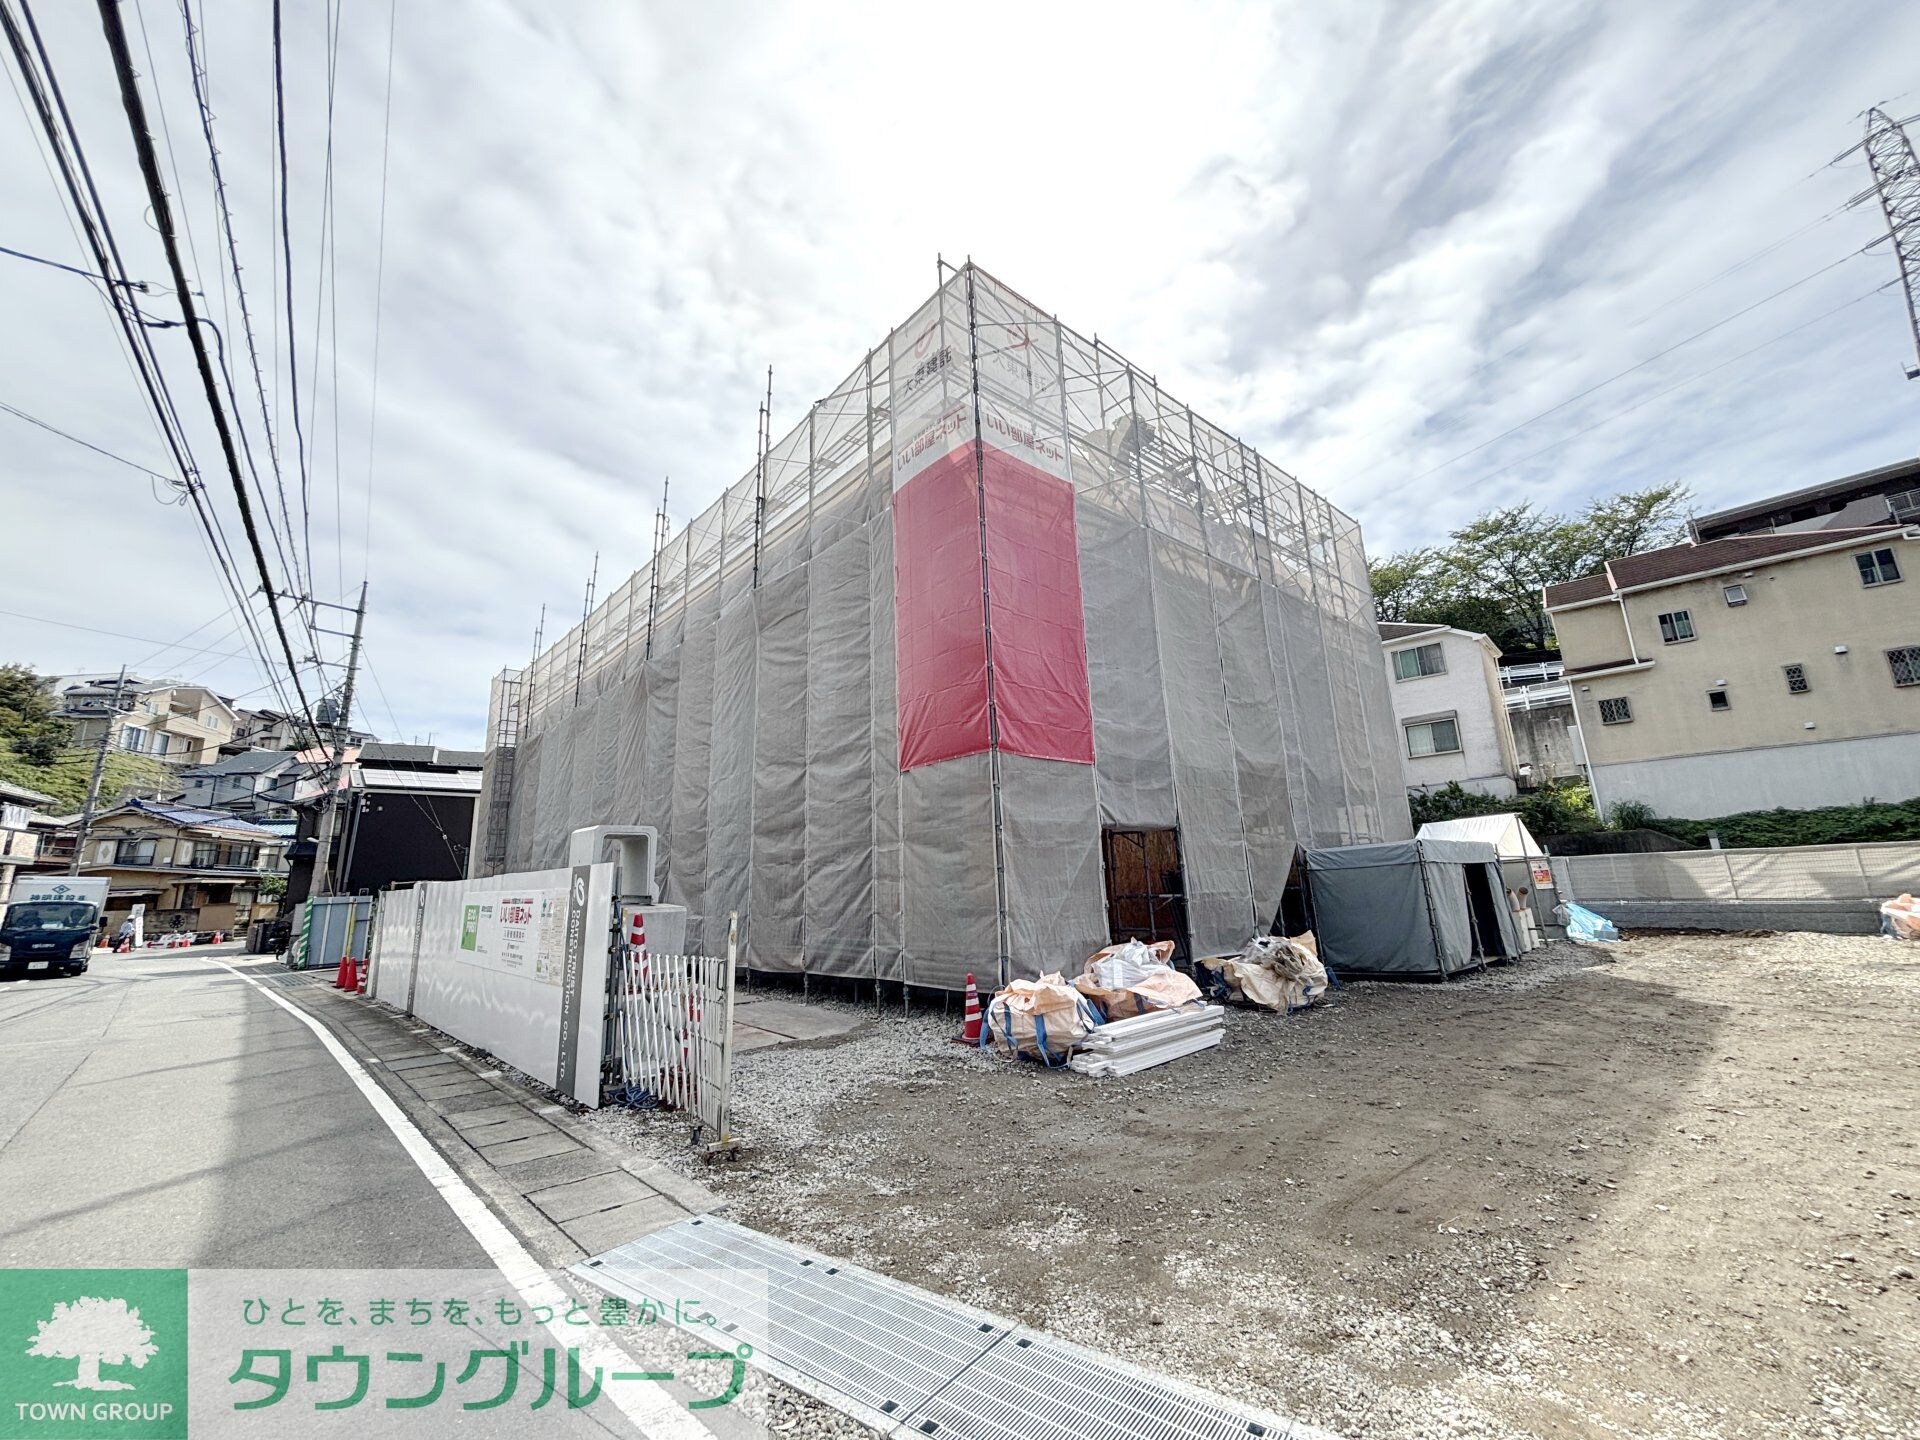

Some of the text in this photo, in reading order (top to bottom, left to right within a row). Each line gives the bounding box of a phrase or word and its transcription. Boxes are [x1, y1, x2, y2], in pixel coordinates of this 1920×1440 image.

[897, 413, 967, 471] いい部屋ネット
[986, 413, 1064, 462] いい部屋ネット
[564, 910, 576, 1014] CONSTRUCTION
[570, 910, 581, 997] DAITO TRUST
